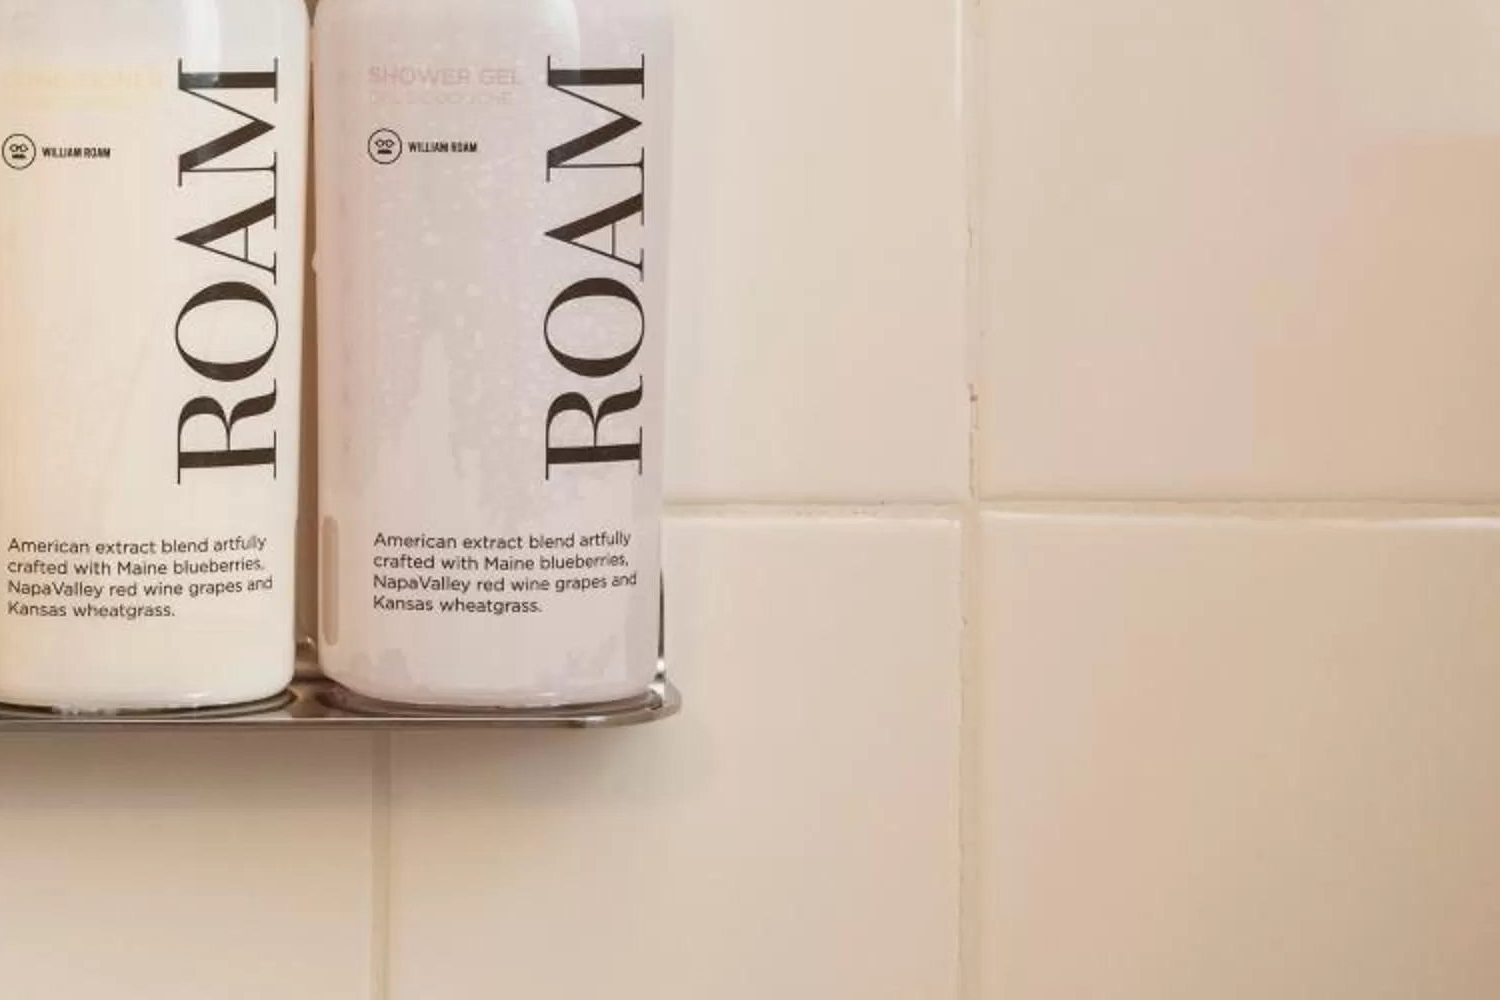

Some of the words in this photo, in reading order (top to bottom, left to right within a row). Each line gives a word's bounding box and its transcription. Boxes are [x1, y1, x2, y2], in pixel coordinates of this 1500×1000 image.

[367, 66, 470, 87] SHOWER
[42, 147, 82, 158] WILLIAM
[83, 147, 111, 159] ROAM
[408, 142, 449, 153] WILLIAM
[451, 142, 478, 153] ROAM
[174, 57, 279, 485] ROAM
[542, 53, 645, 481] ROAM
[8, 538, 90, 554] American
[95, 540, 156, 554] extract
[161, 538, 208, 553] blend
[213, 536, 266, 552] artfully
[373, 532, 457, 549] American
[463, 536, 522, 550] extract
[529, 534, 574, 549] blend
[579, 530, 632, 548] artfully
[8, 559, 67, 574] crafted
[74, 561, 110, 575] with
[117, 562, 167, 575] Maine
[373, 554, 434, 569] crafted
[440, 556, 478, 570] with
[484, 557, 534, 570] Maine
[8, 580, 102, 598] NapaValley
[109, 582, 136, 596] red
[143, 583, 182, 596] wine
[189, 582, 242, 598] grapes
[248, 576, 272, 591] and
[373, 574, 469, 593] NapaValley
[477, 577, 504, 591] red
[510, 579, 550, 591] wine
[555, 577, 607, 592] grapes
[612, 572, 636, 586] and
[8, 602, 66, 616] Kansas
[72, 604, 175, 620] wheatgrass.
[373, 596, 433, 611] Kansas
[440, 598, 542, 615] wheatgrass.
